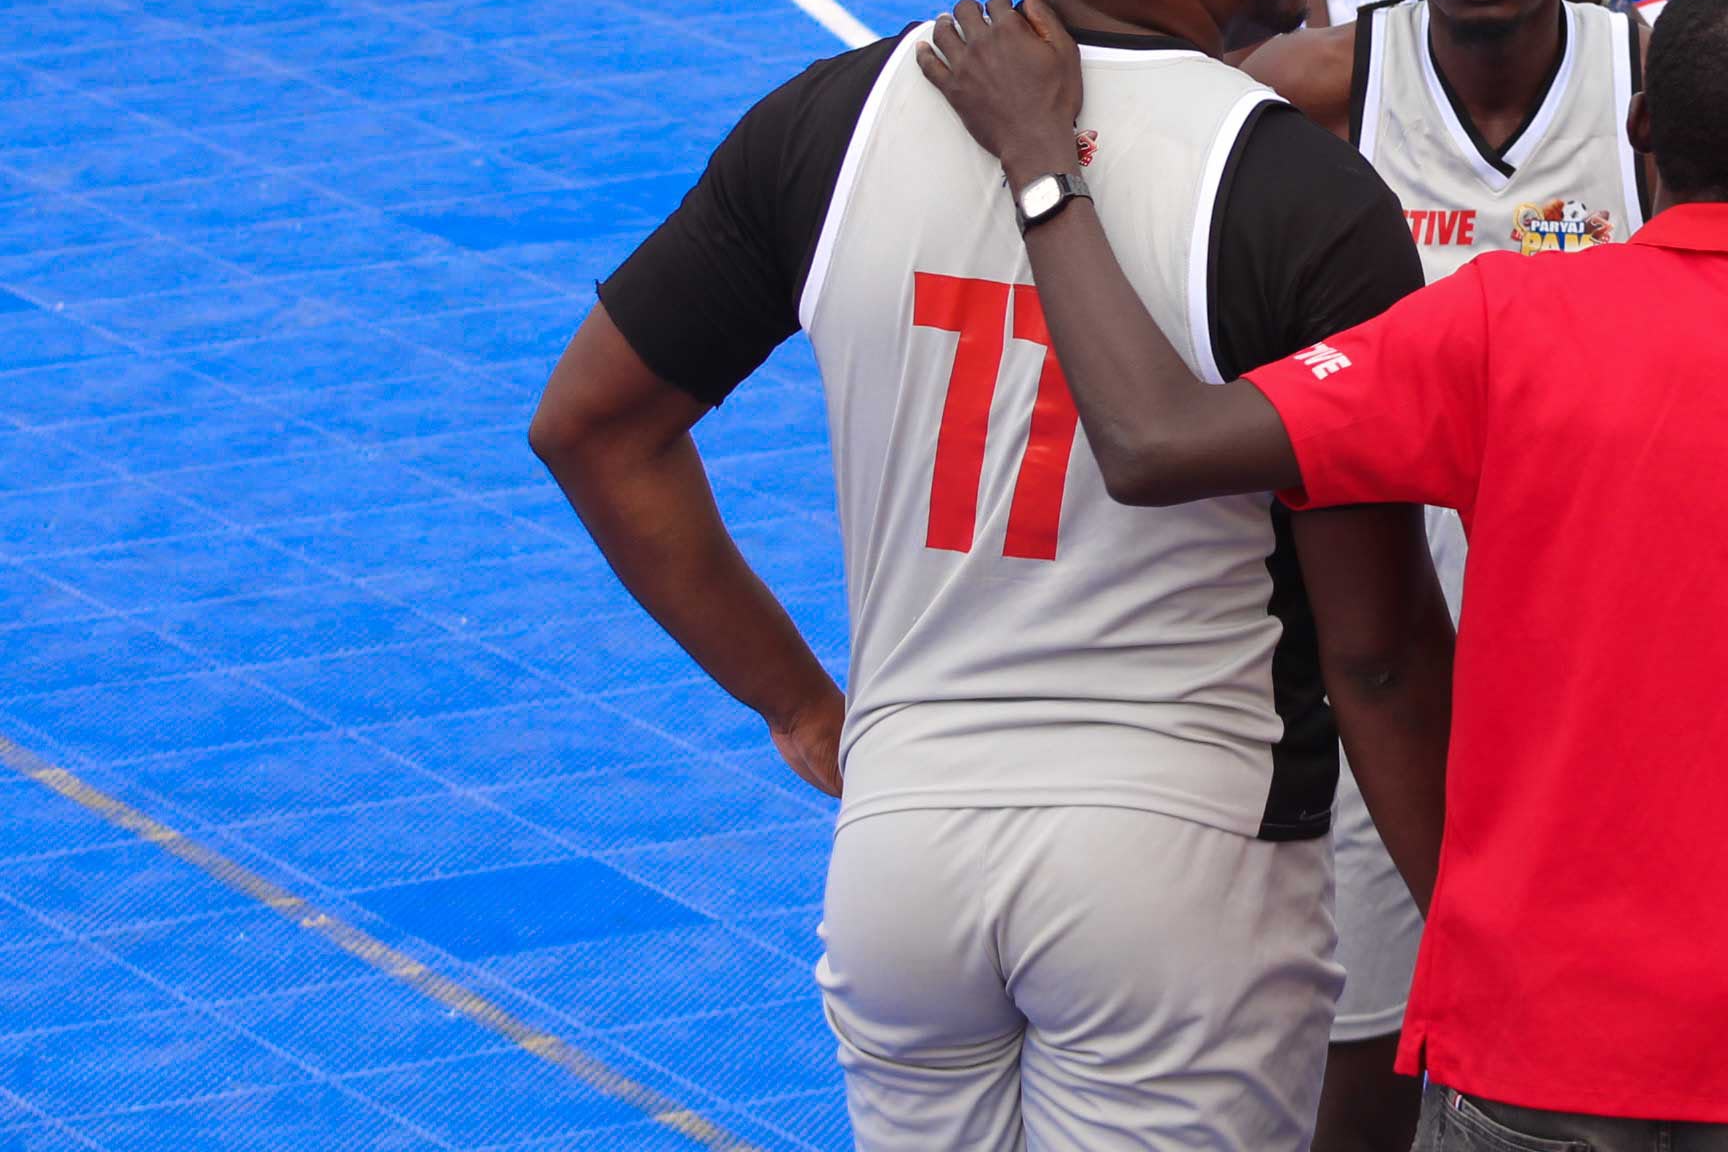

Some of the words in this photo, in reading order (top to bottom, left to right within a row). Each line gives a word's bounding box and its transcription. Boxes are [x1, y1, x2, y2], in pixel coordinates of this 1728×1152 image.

[1403, 209, 1477, 246] TIVE
[1531, 220, 1585, 234] PARYAJ
[912, 271, 1079, 561] 77
